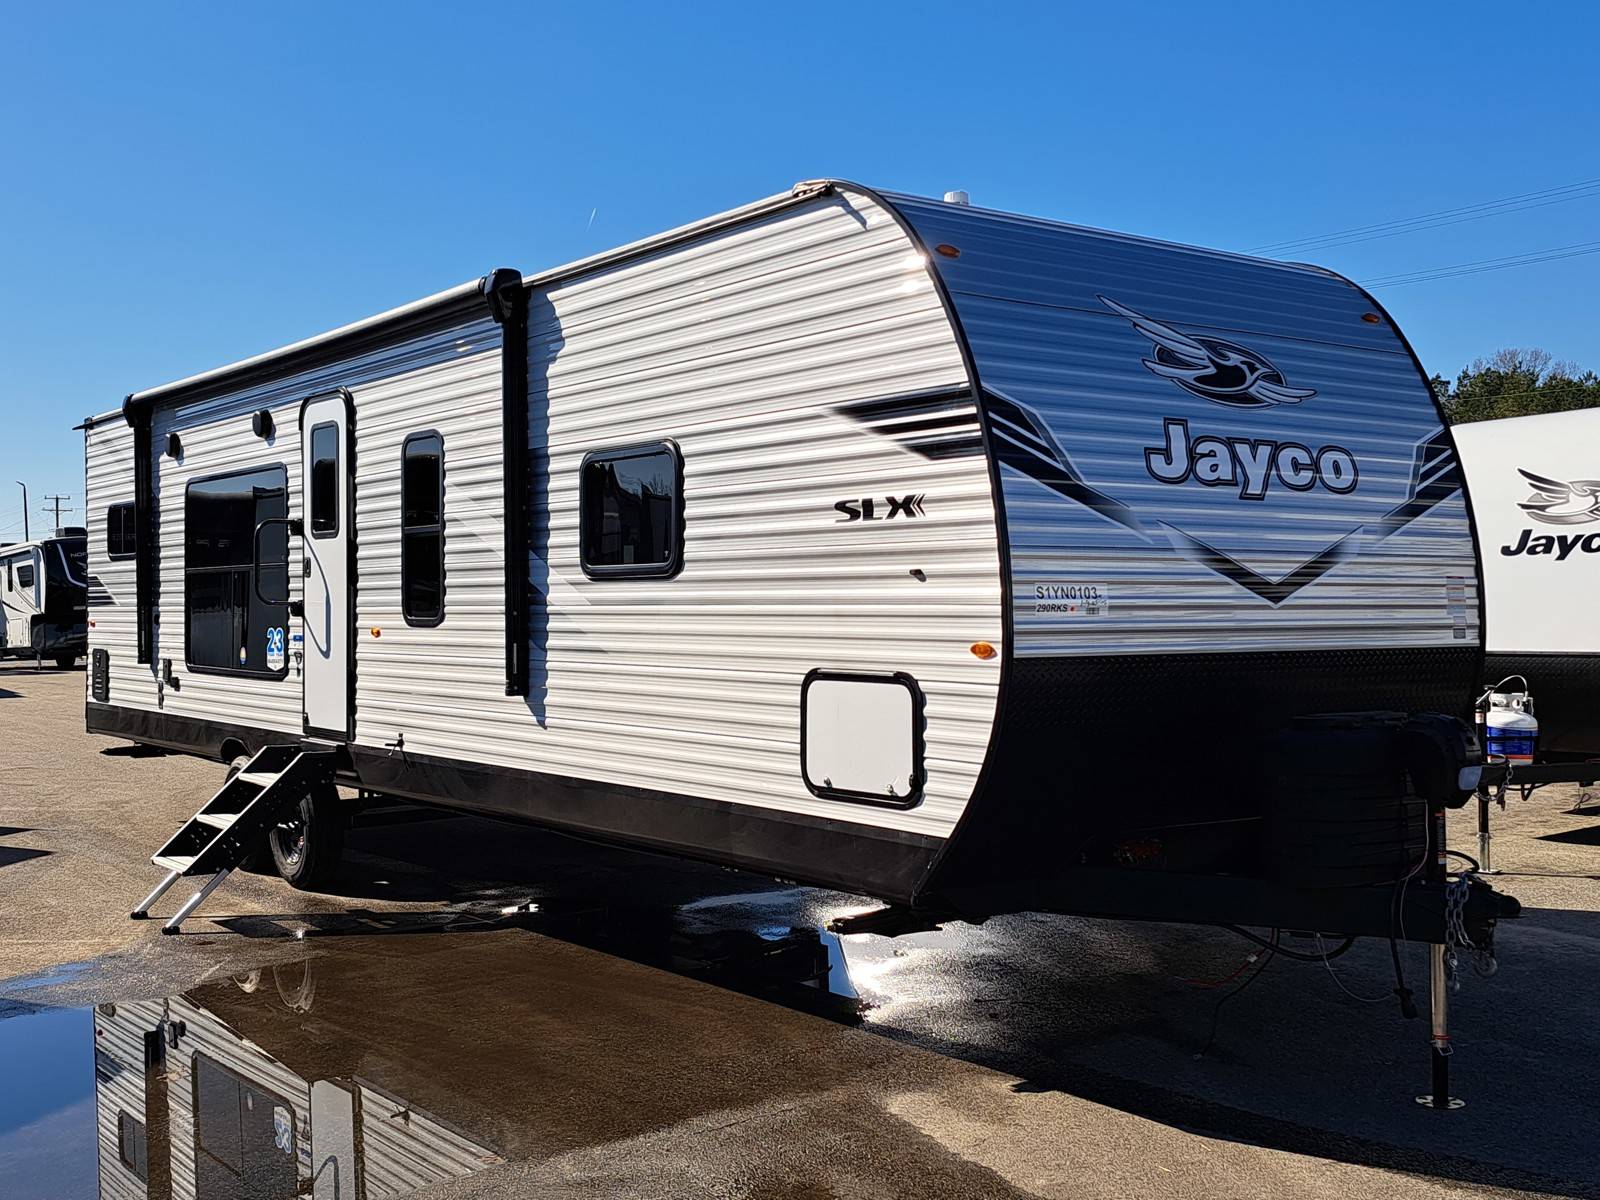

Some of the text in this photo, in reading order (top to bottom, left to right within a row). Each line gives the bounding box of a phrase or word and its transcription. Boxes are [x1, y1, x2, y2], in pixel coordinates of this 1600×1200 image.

[1144, 417, 1359, 500] Jayco
[834, 494, 919, 523] SLX
[1036, 586, 1097, 600] S1YN0103
[1036, 603, 1068, 613] 290RKS
